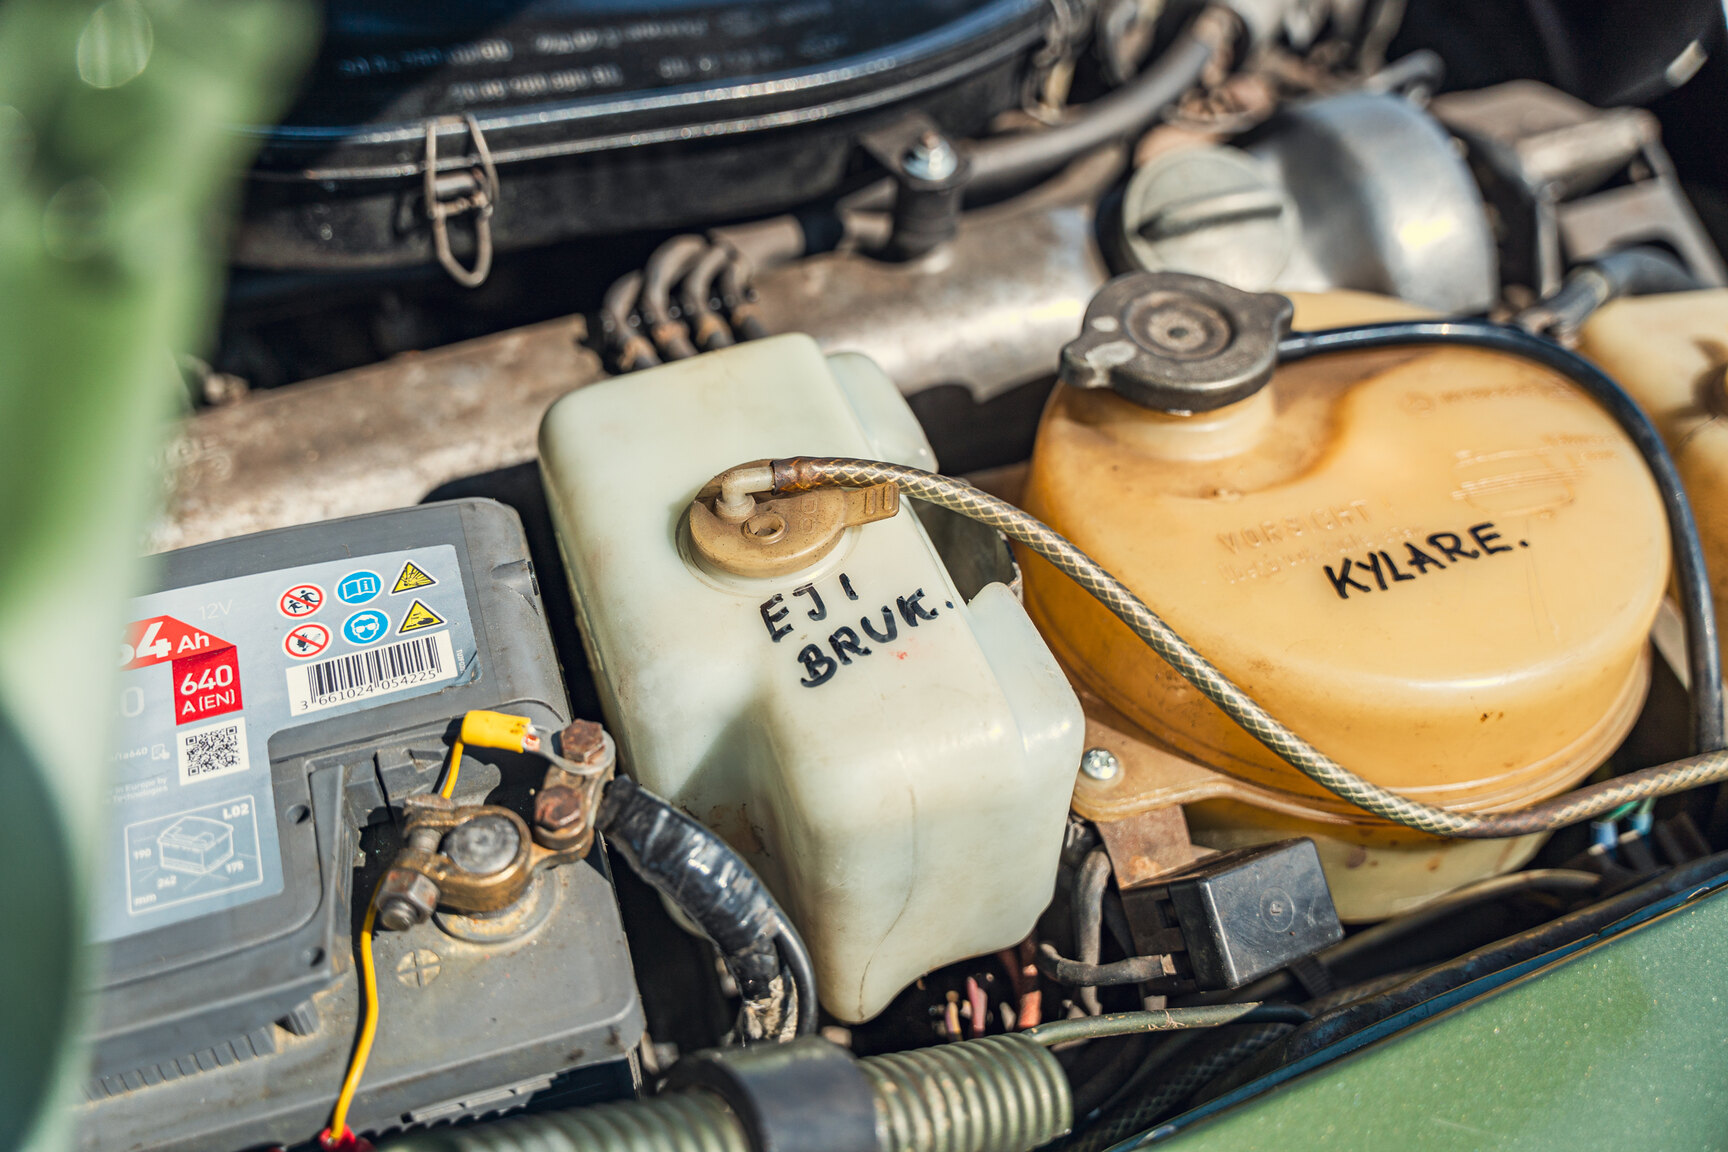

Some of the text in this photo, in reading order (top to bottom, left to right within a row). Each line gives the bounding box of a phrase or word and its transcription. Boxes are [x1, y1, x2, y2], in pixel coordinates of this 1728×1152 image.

[1323, 521, 1530, 599] KYLARE.
[199, 599, 233, 621] 12V
[177, 632, 210, 654] Ah
[797, 587, 954, 688] BRUK.
[180, 665, 233, 696] 640
[301, 670, 436, 711] 3 661024 054225
[182, 688, 236, 716] A (EN)
